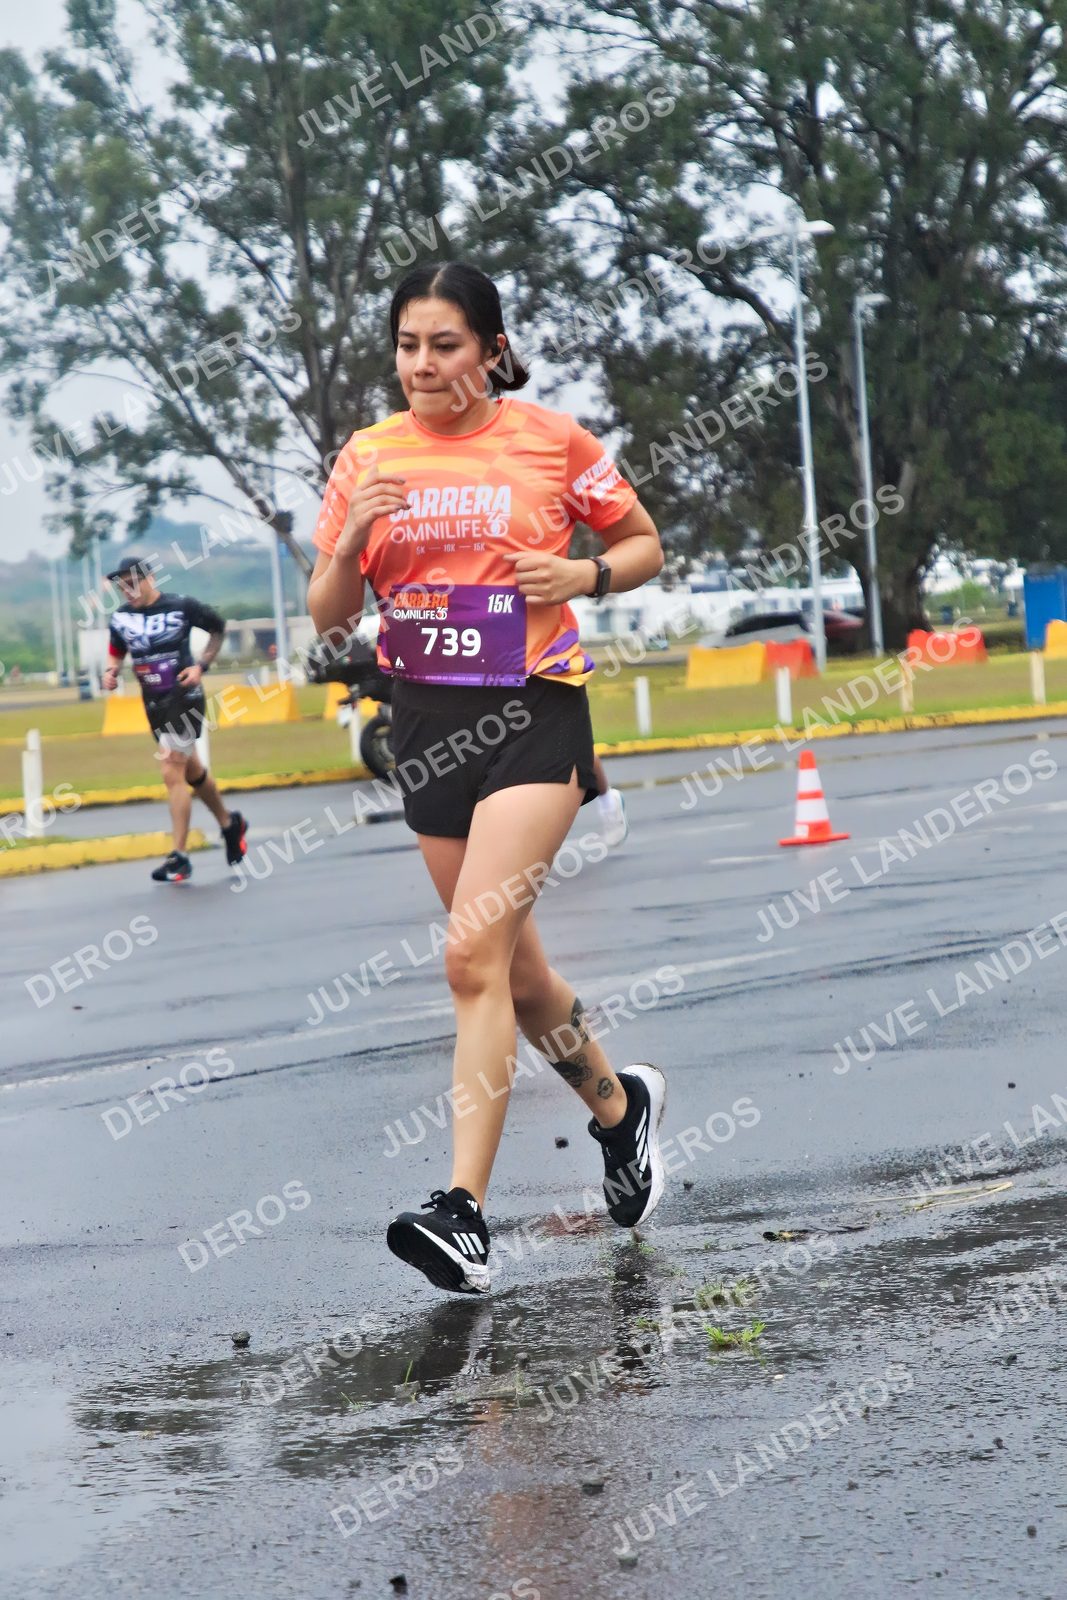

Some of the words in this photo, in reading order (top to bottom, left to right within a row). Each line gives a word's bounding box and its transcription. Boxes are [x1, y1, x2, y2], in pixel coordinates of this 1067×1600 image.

[394, 592, 448, 608] CARRERA
[488, 594, 514, 614] 15K
[421, 628, 482, 656] 739
